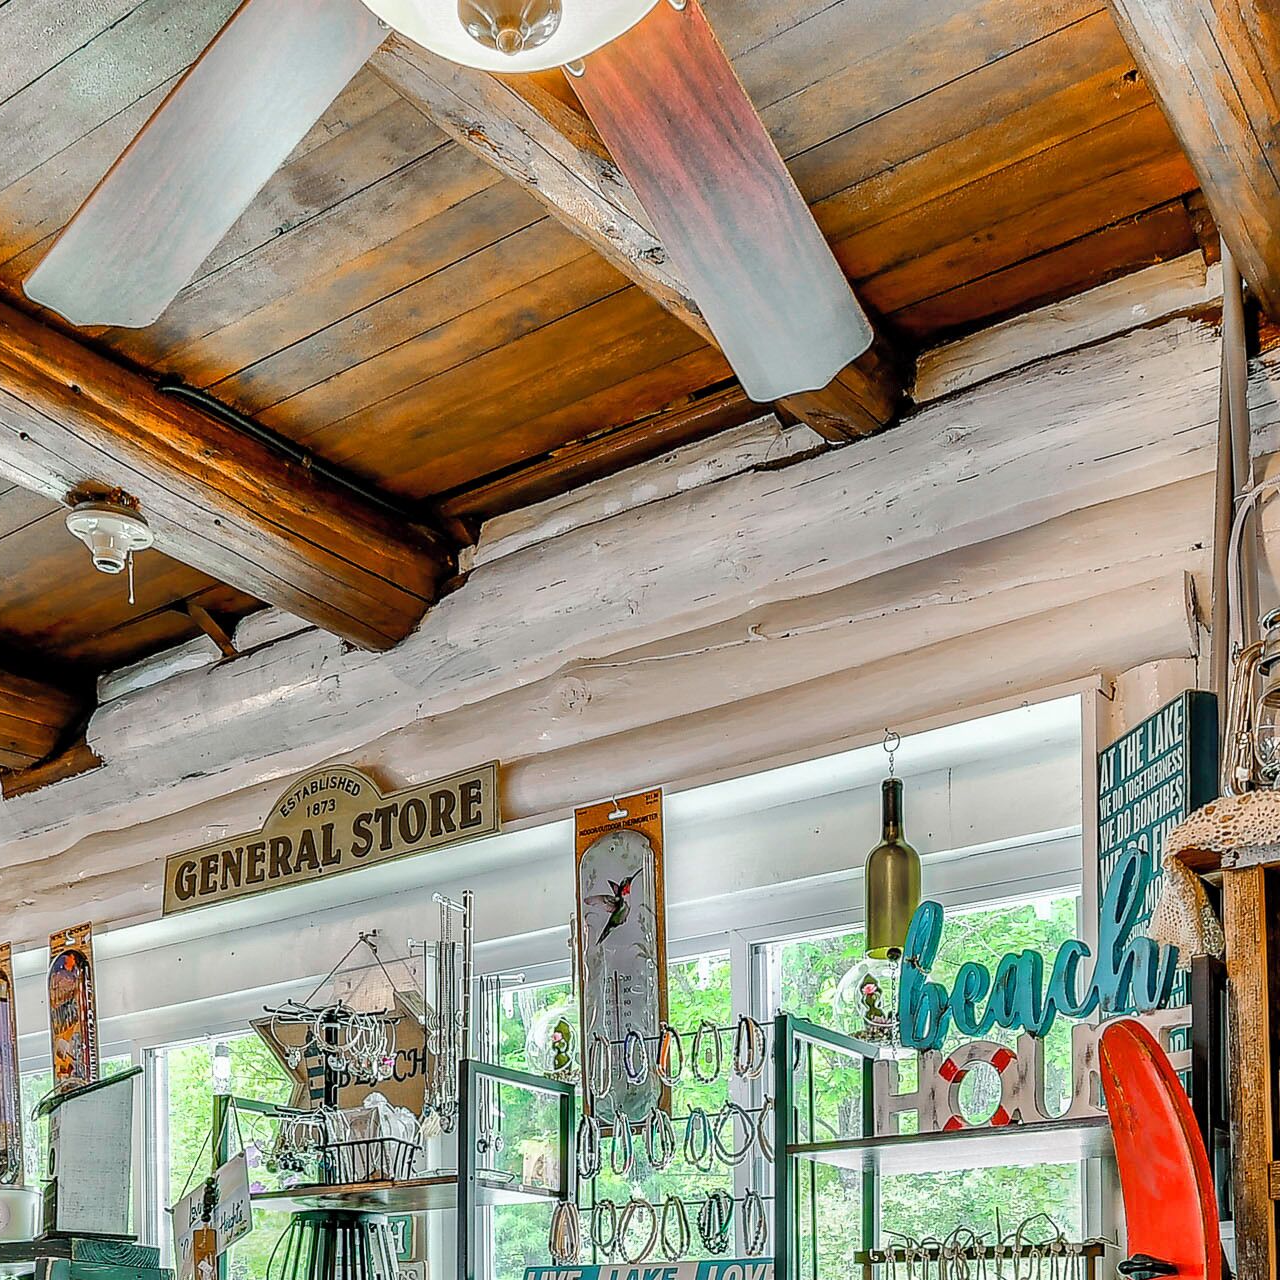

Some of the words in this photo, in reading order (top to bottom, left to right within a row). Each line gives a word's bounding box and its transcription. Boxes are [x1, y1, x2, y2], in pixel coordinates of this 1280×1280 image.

[1100, 748, 1116, 794] AT
[1119, 727, 1144, 780] THE
[1148, 698, 1183, 761] LAKE
[1125, 747, 1183, 804] TOGETHERNESS
[279, 775, 361, 818] ESTABLISHED
[306, 798, 336, 818] 1873
[1133, 777, 1183, 836] BONFIRES
[174, 823, 341, 901] GENERAL
[350, 779, 482, 858] STORE
[899, 848, 1179, 1050] beach
